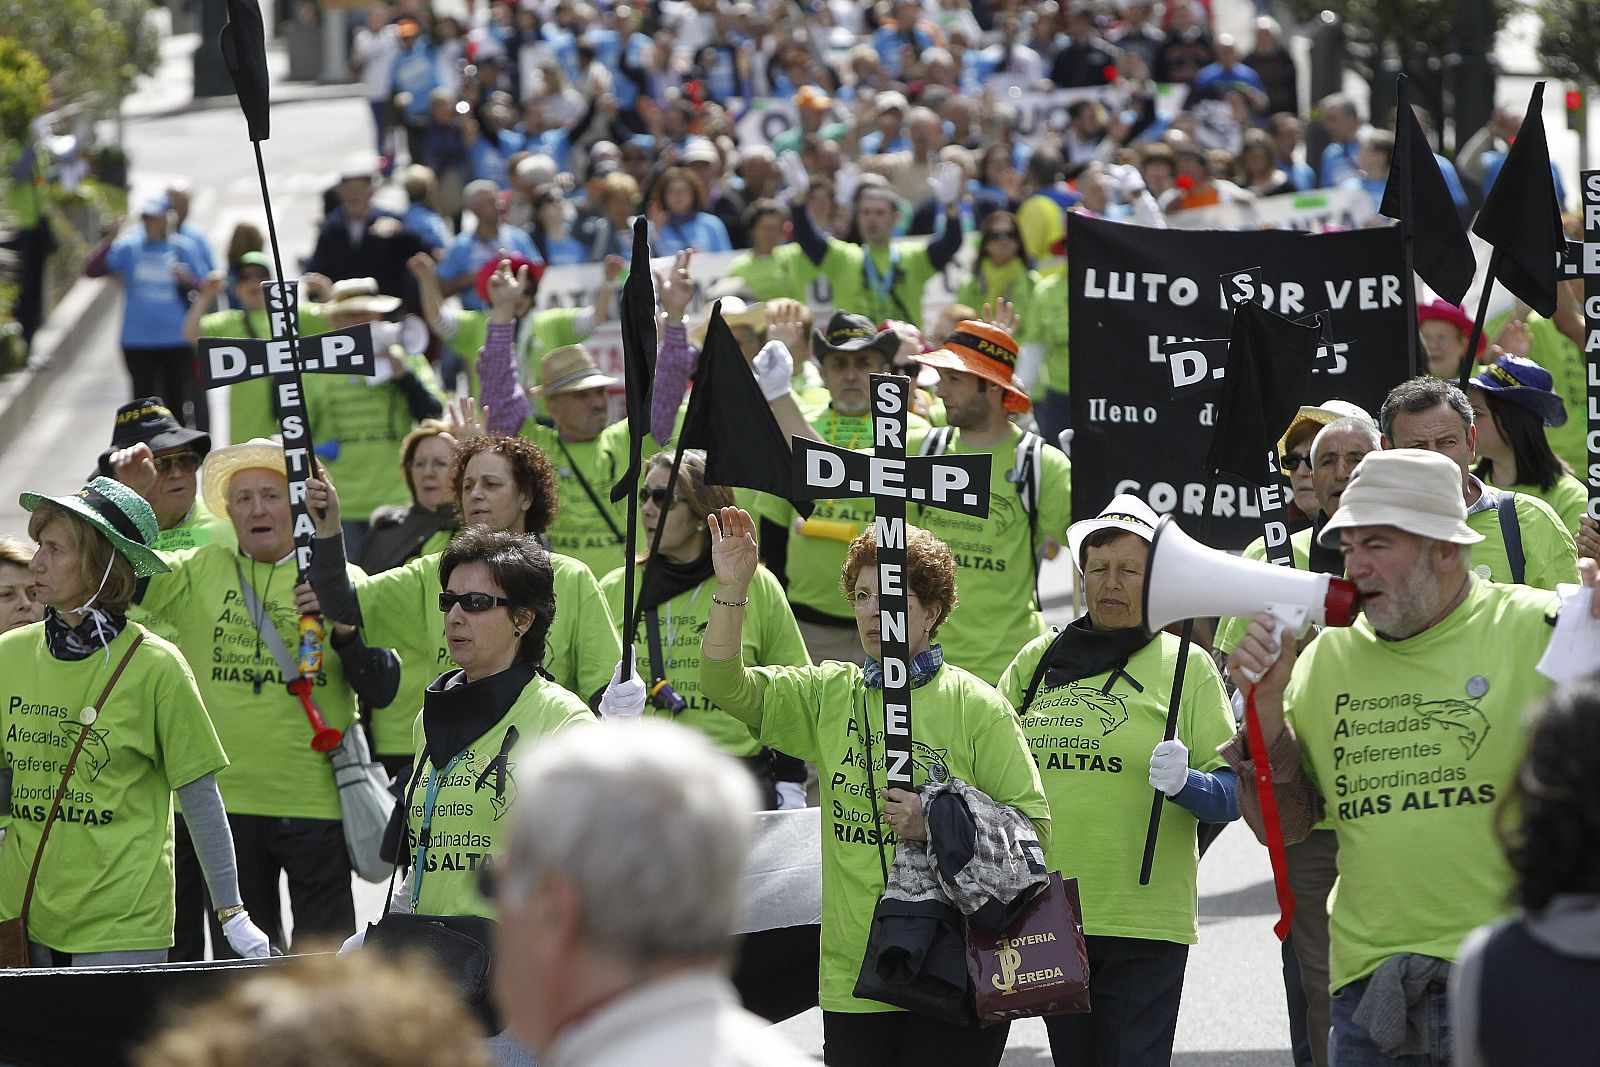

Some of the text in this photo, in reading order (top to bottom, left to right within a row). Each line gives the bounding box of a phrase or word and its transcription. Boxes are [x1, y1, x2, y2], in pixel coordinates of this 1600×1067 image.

[1084, 268, 1199, 306] LUTO
[1325, 274, 1402, 311] VER
[209, 335, 364, 379] D.E.P.
[806, 449, 978, 506] D.E.P.
[875, 382, 911, 782] SR MENDEZ
[1335, 693, 1424, 715] Personas
[1334, 716, 1432, 741] Afectadas
[1046, 752, 1123, 773] ALTAS
[1334, 742, 1442, 770] Preferentes
[1335, 766, 1467, 797] Subordinadas
[1338, 783, 1497, 821] RIAS ALTAS
